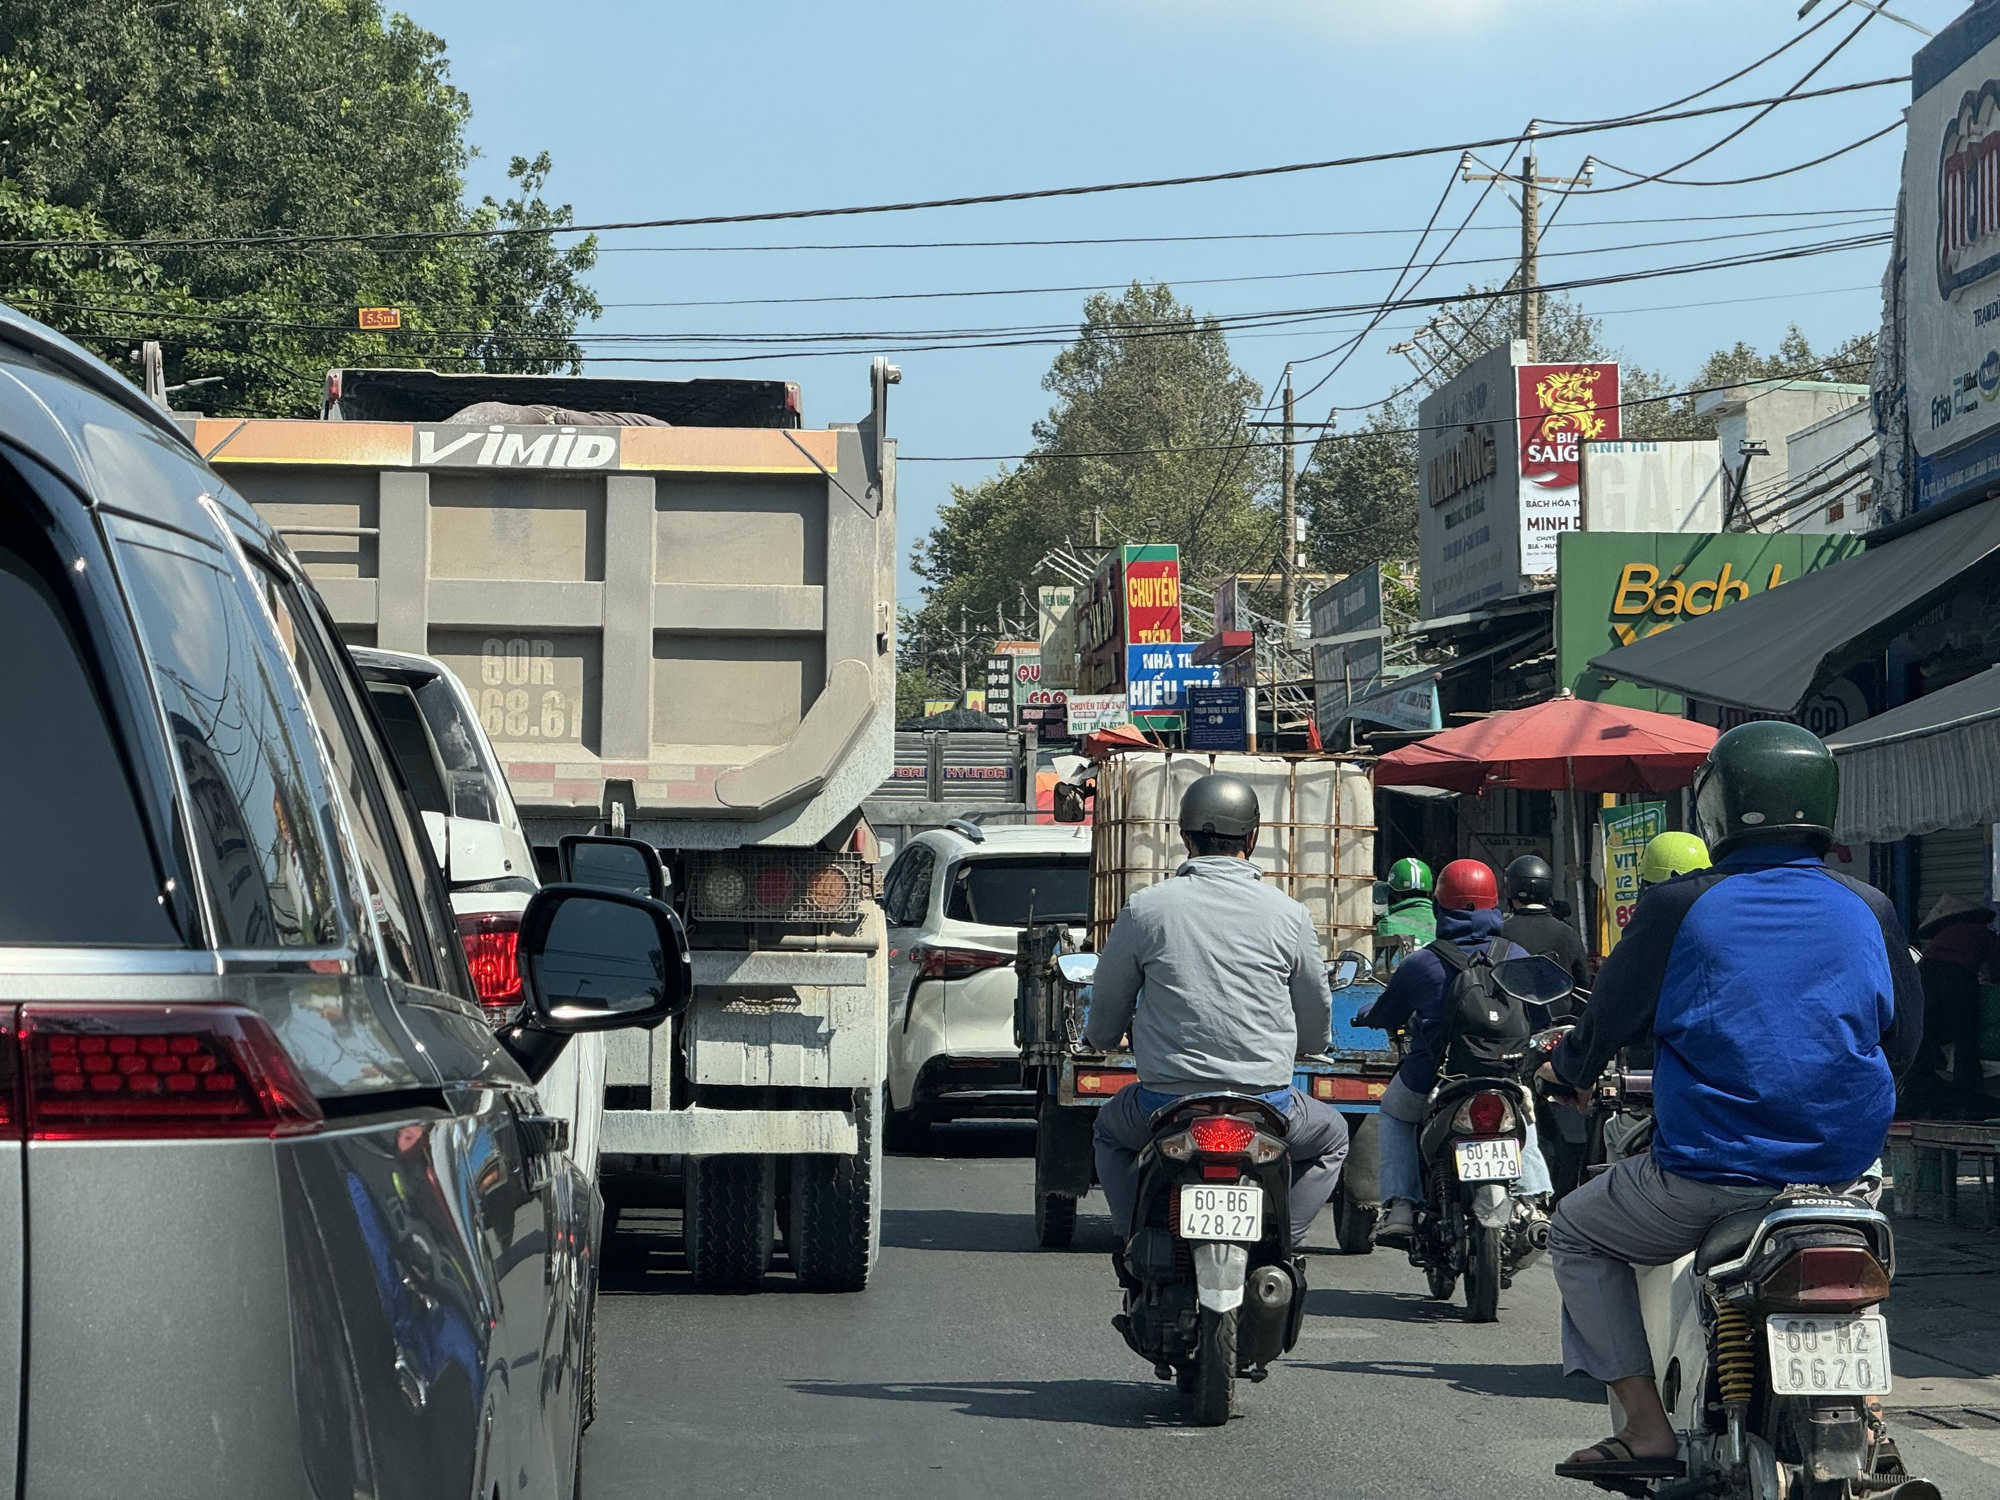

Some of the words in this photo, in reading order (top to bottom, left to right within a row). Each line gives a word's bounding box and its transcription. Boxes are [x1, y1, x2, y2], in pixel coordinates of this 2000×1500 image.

[367, 313, 394, 323] 5.5m
[1527, 445, 1579, 462] SAIG
[1526, 499, 1549, 507] BÁCH
[1551, 498, 1570, 507] HÓA
[1527, 517, 1568, 530] MINH
[1129, 566, 1178, 608] CHUYỂN
[1613, 562, 1750, 616] Bách
[481, 638, 554, 685] 60R
[1143, 650, 1174, 669] NHÀ
[1016, 664, 1040, 684] QU
[1129, 672, 1178, 706] HIẾU
[1072, 720, 1088, 731] RÚT
[893, 768, 926, 779] NDAI
[946, 768, 1010, 779] HYUNDAI
[1613, 851, 1638, 871] VỊT
[1466, 1142, 1508, 1160] 60-AA
[1462, 1160, 1517, 1179] 231.29
[1195, 1190, 1247, 1212] 60-B6
[1791, 1198, 1855, 1208] HONDA
[1187, 1213, 1255, 1237] 428.27
[1788, 1357, 1872, 1390] 6620
